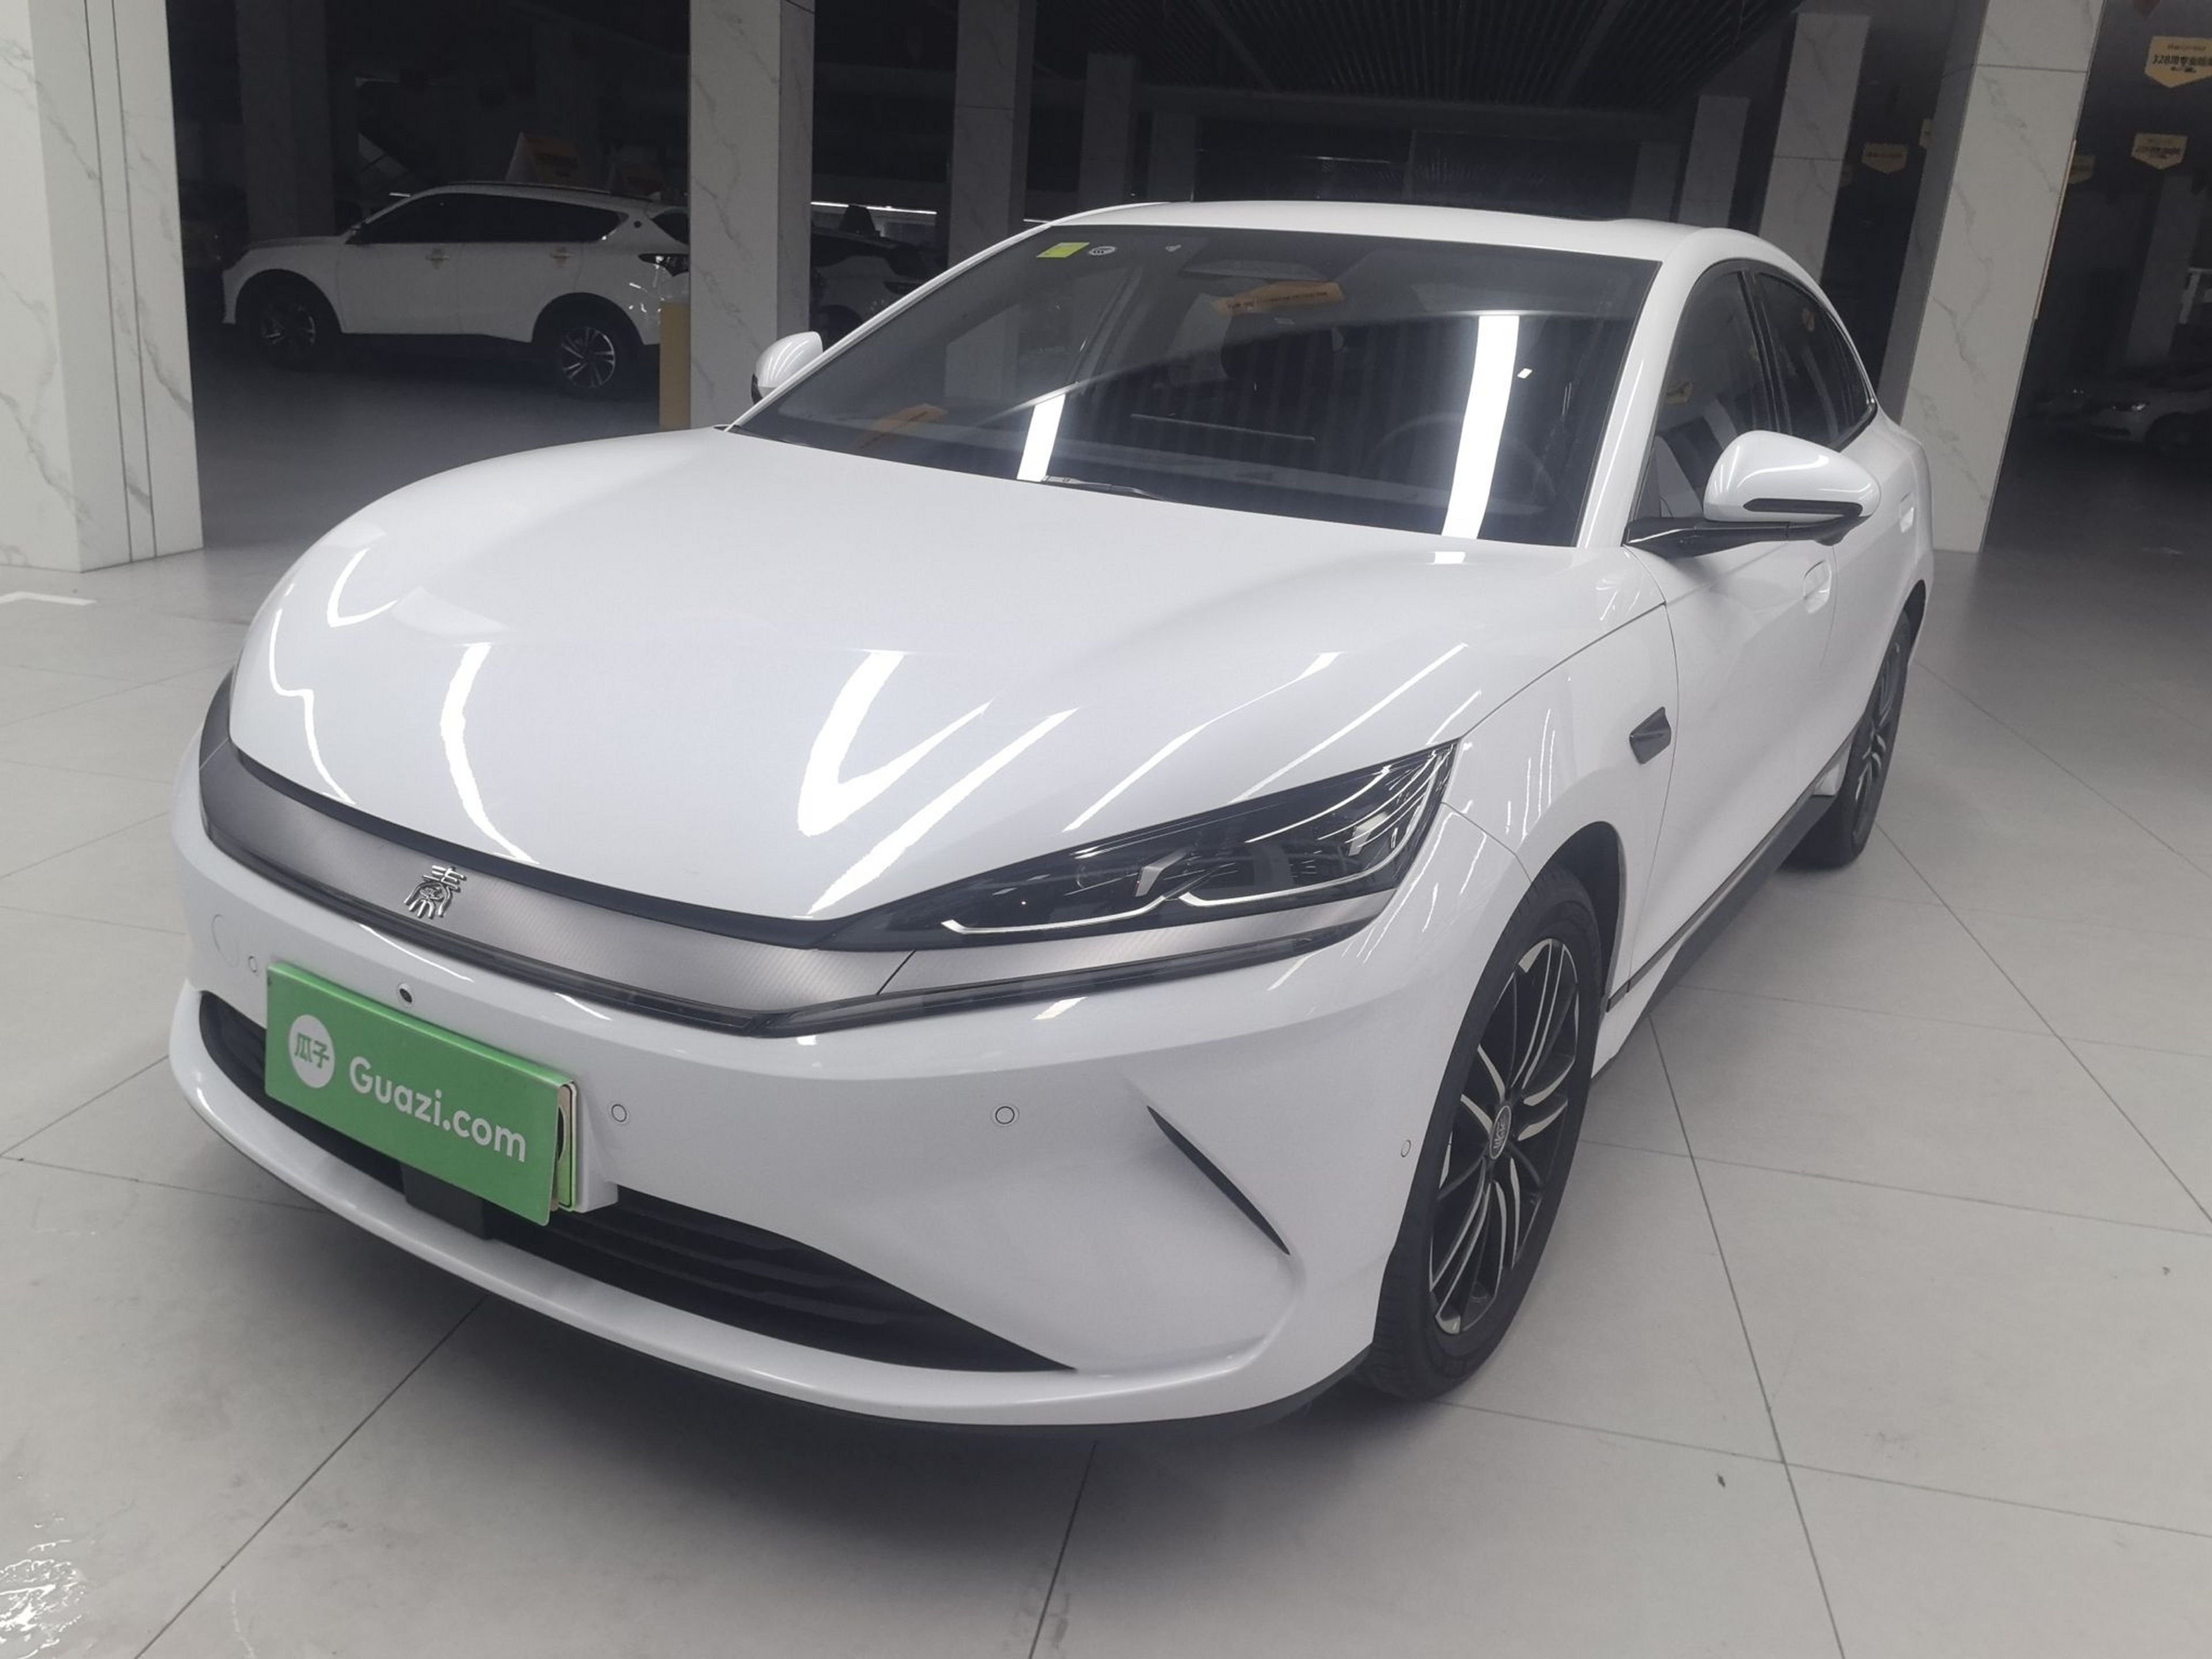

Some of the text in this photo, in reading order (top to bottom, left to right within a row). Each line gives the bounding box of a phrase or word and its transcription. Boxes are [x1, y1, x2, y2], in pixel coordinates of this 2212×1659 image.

[403, 864, 468, 920] 秦
[295, 1032, 330, 1069] 瓜子
[350, 1056, 527, 1162] Guazi.com
